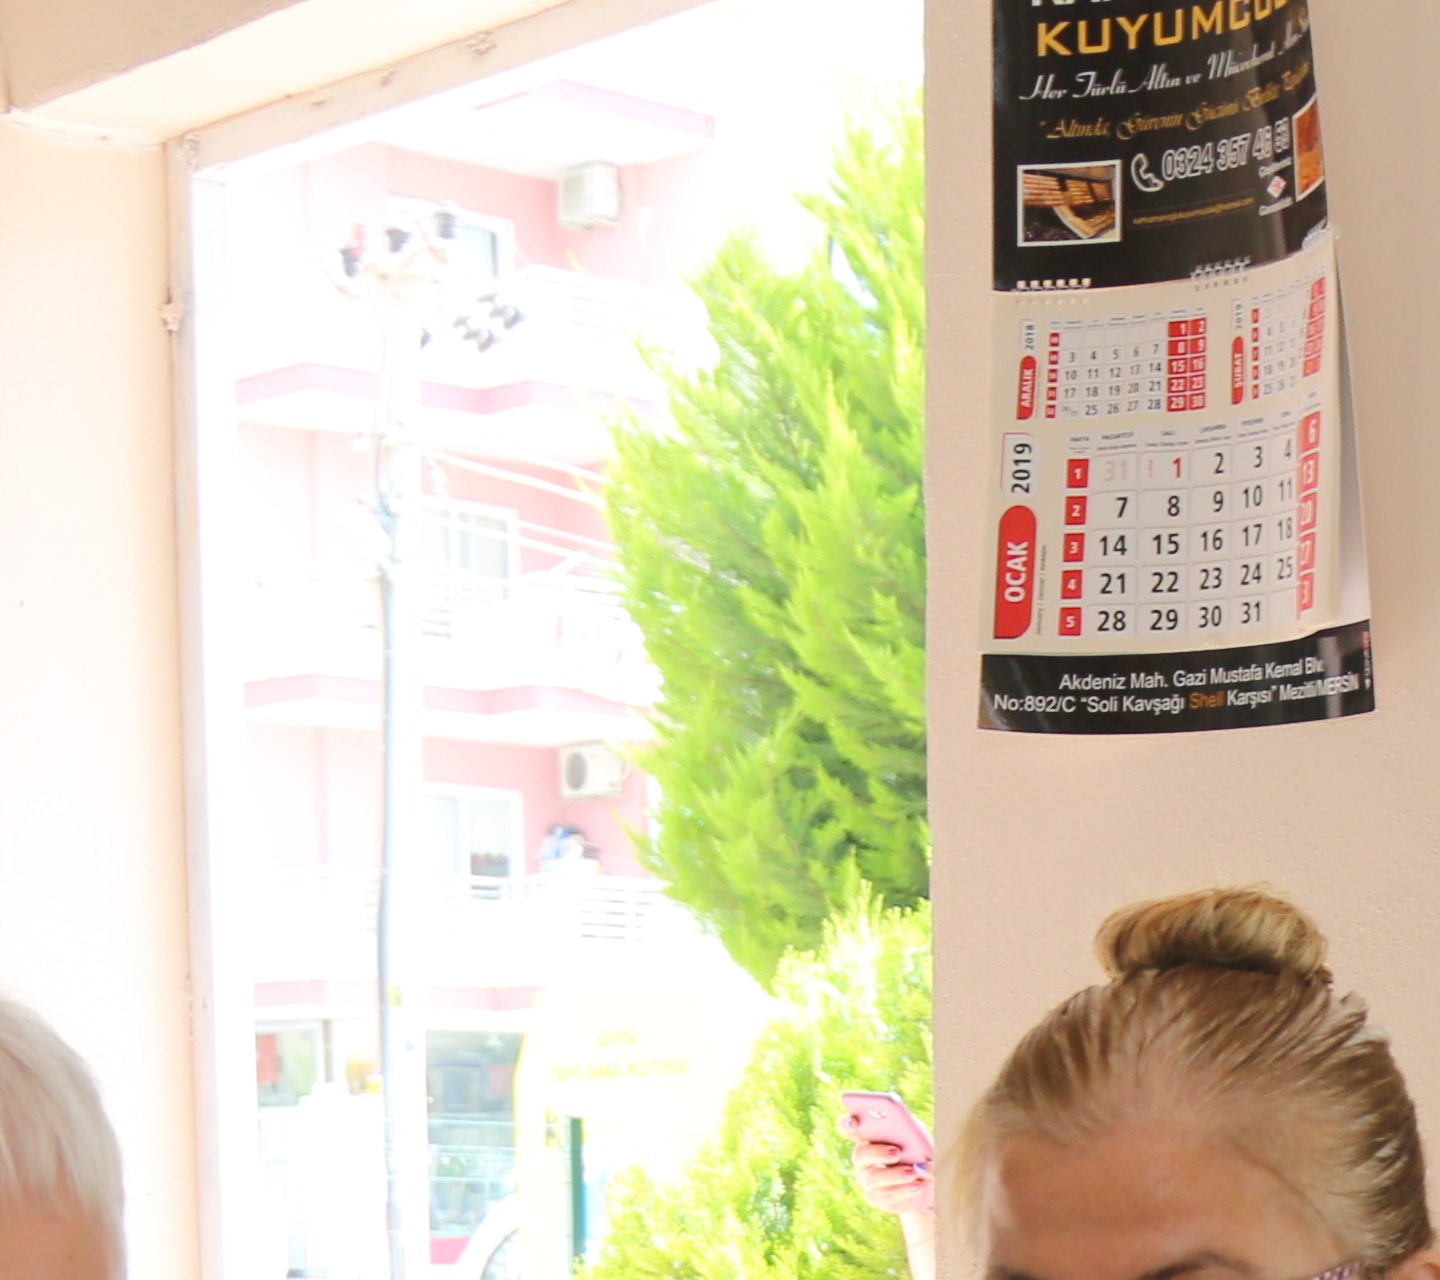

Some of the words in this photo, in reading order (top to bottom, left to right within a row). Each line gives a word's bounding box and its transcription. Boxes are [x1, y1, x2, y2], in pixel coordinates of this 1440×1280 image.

[1019, 74, 1066, 100] Her
[1073, 67, 1128, 99] Türlü
[1128, 64, 1181, 93] Altın
[1186, 73, 1201, 85] ve
[1162, 143, 1214, 180] 0324
[1217, 133, 1251, 171] 357
[1024, 324, 1035, 350] 2018
[1180, 324, 1186, 334] 1
[1198, 322, 1205, 332] 2
[1065, 370, 1076, 380] 10
[1088, 369, 1099, 378] 11
[1110, 368, 1121, 378] 12
[1130, 366, 1140, 375] 13
[1149, 363, 1162, 373] 14
[1172, 361, 1186, 372] 15
[1193, 360, 1204, 370] 16
[1069, 352, 1075, 363] 3
[1090, 351, 1096, 360] 4
[1113, 349, 1119, 358] 5
[1133, 347, 1139, 357] 6
[1153, 344, 1159, 354] 7
[1178, 342, 1185, 353] 8
[1198, 341, 1205, 351] 9
[1020, 368, 1036, 408] ARALIK
[1064, 388, 1076, 398] 17
[1086, 387, 1098, 397] 18
[1109, 386, 1120, 396] 19
[1128, 383, 1139, 394] 20
[1149, 381, 1161, 391] 21
[1171, 380, 1184, 391] 22
[1192, 378, 1204, 388] 23
[1085, 405, 1098, 416] 25
[1107, 404, 1119, 414] 26
[1127, 401, 1138, 412] 27
[1148, 399, 1161, 410] 28
[1171, 398, 1184, 409] 29
[1191, 396, 1204, 407] 30
[1074, 468, 1082, 480] 1
[1172, 456, 1182, 479] 1
[1214, 452, 1225, 475] 2
[1253, 446, 1263, 468] 3
[1284, 438, 1292, 460] 4
[1308, 419, 1316, 444] 6
[1011, 443, 1033, 494] 2019
[1072, 504, 1081, 517] 2
[1117, 496, 1128, 518] 7
[1167, 495, 1180, 517] 8
[1212, 490, 1224, 512] 9
[1242, 485, 1263, 508] 10
[1278, 479, 1293, 501] 11
[1301, 461, 1315, 486] 13
[1069, 542, 1079, 554] 3
[1099, 534, 1128, 556] 14
[1152, 532, 1180, 555] 15
[1201, 528, 1223, 552] 16
[1242, 523, 1262, 546] 17
[1277, 516, 1293, 540] 18
[1004, 540, 1029, 603] OCAK
[1067, 579, 1077, 590] 4
[1099, 572, 1127, 594] 21
[1151, 570, 1179, 593] 22
[1199, 566, 1223, 590] 23
[1240, 561, 1262, 585] 24
[1276, 555, 1293, 579] 25
[1066, 615, 1075, 628] 5
[1096, 609, 1127, 632] 28
[1150, 608, 1179, 631] 29
[1198, 604, 1222, 628] 30
[1241, 600, 1262, 623] 31
[1302, 581, 1310, 602] 3
[1059, 674, 1126, 690] Akdeniz
[1130, 672, 1169, 689] Mah.
[1173, 669, 1206, 687] Gazi
[1210, 665, 1263, 685] Mustafa
[1265, 659, 1303, 679] Kemal
[993, 694, 1076, 713] No:892/C
[1122, 694, 1185, 716] Kavşağı
[1189, 691, 1224, 709] Shell
